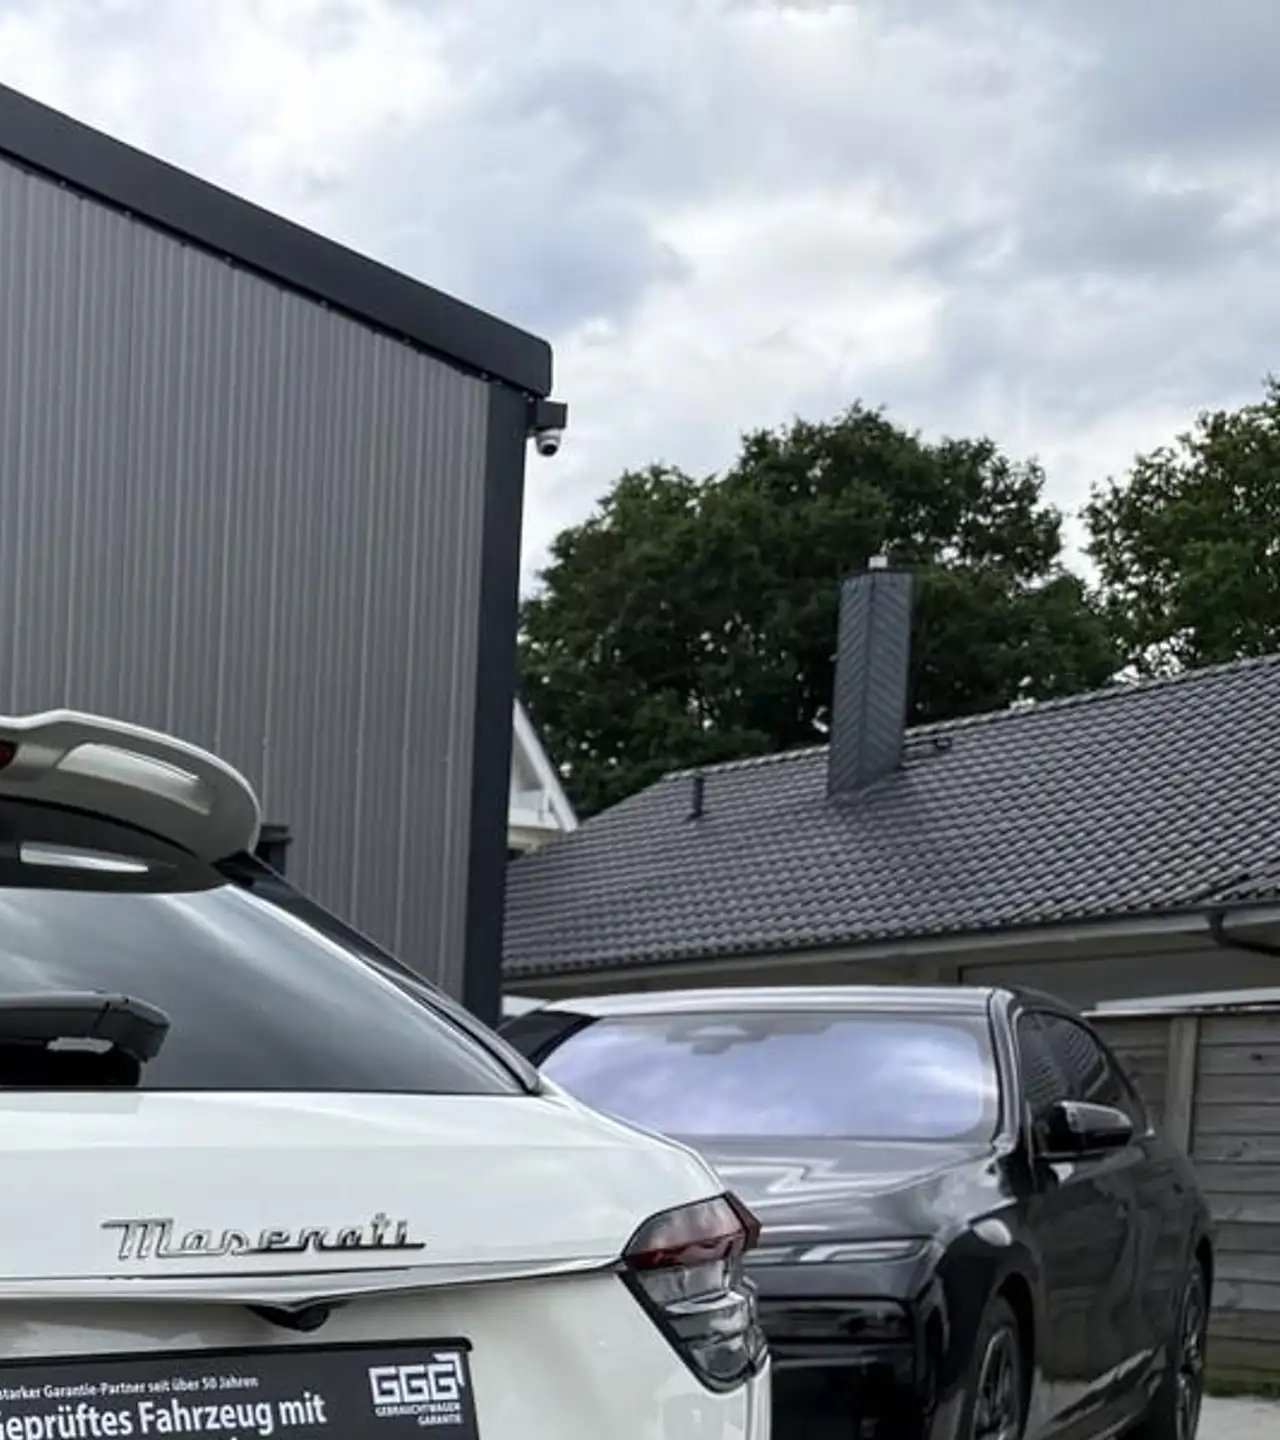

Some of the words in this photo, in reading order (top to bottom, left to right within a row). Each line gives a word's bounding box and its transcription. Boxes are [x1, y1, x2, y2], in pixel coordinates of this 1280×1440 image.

[101, 1212, 426, 1260] Maserati
[44, 1382, 146, 1398] Garantie-Partner
[148, 1380, 170, 1393] seit
[172, 1377, 200, 1392] über
[220, 1375, 259, 1391] Jahren
[369, 1363, 460, 1405] GGG
[138, 1398, 274, 1436] Fahrzeug
[279, 1391, 327, 1425] mit
